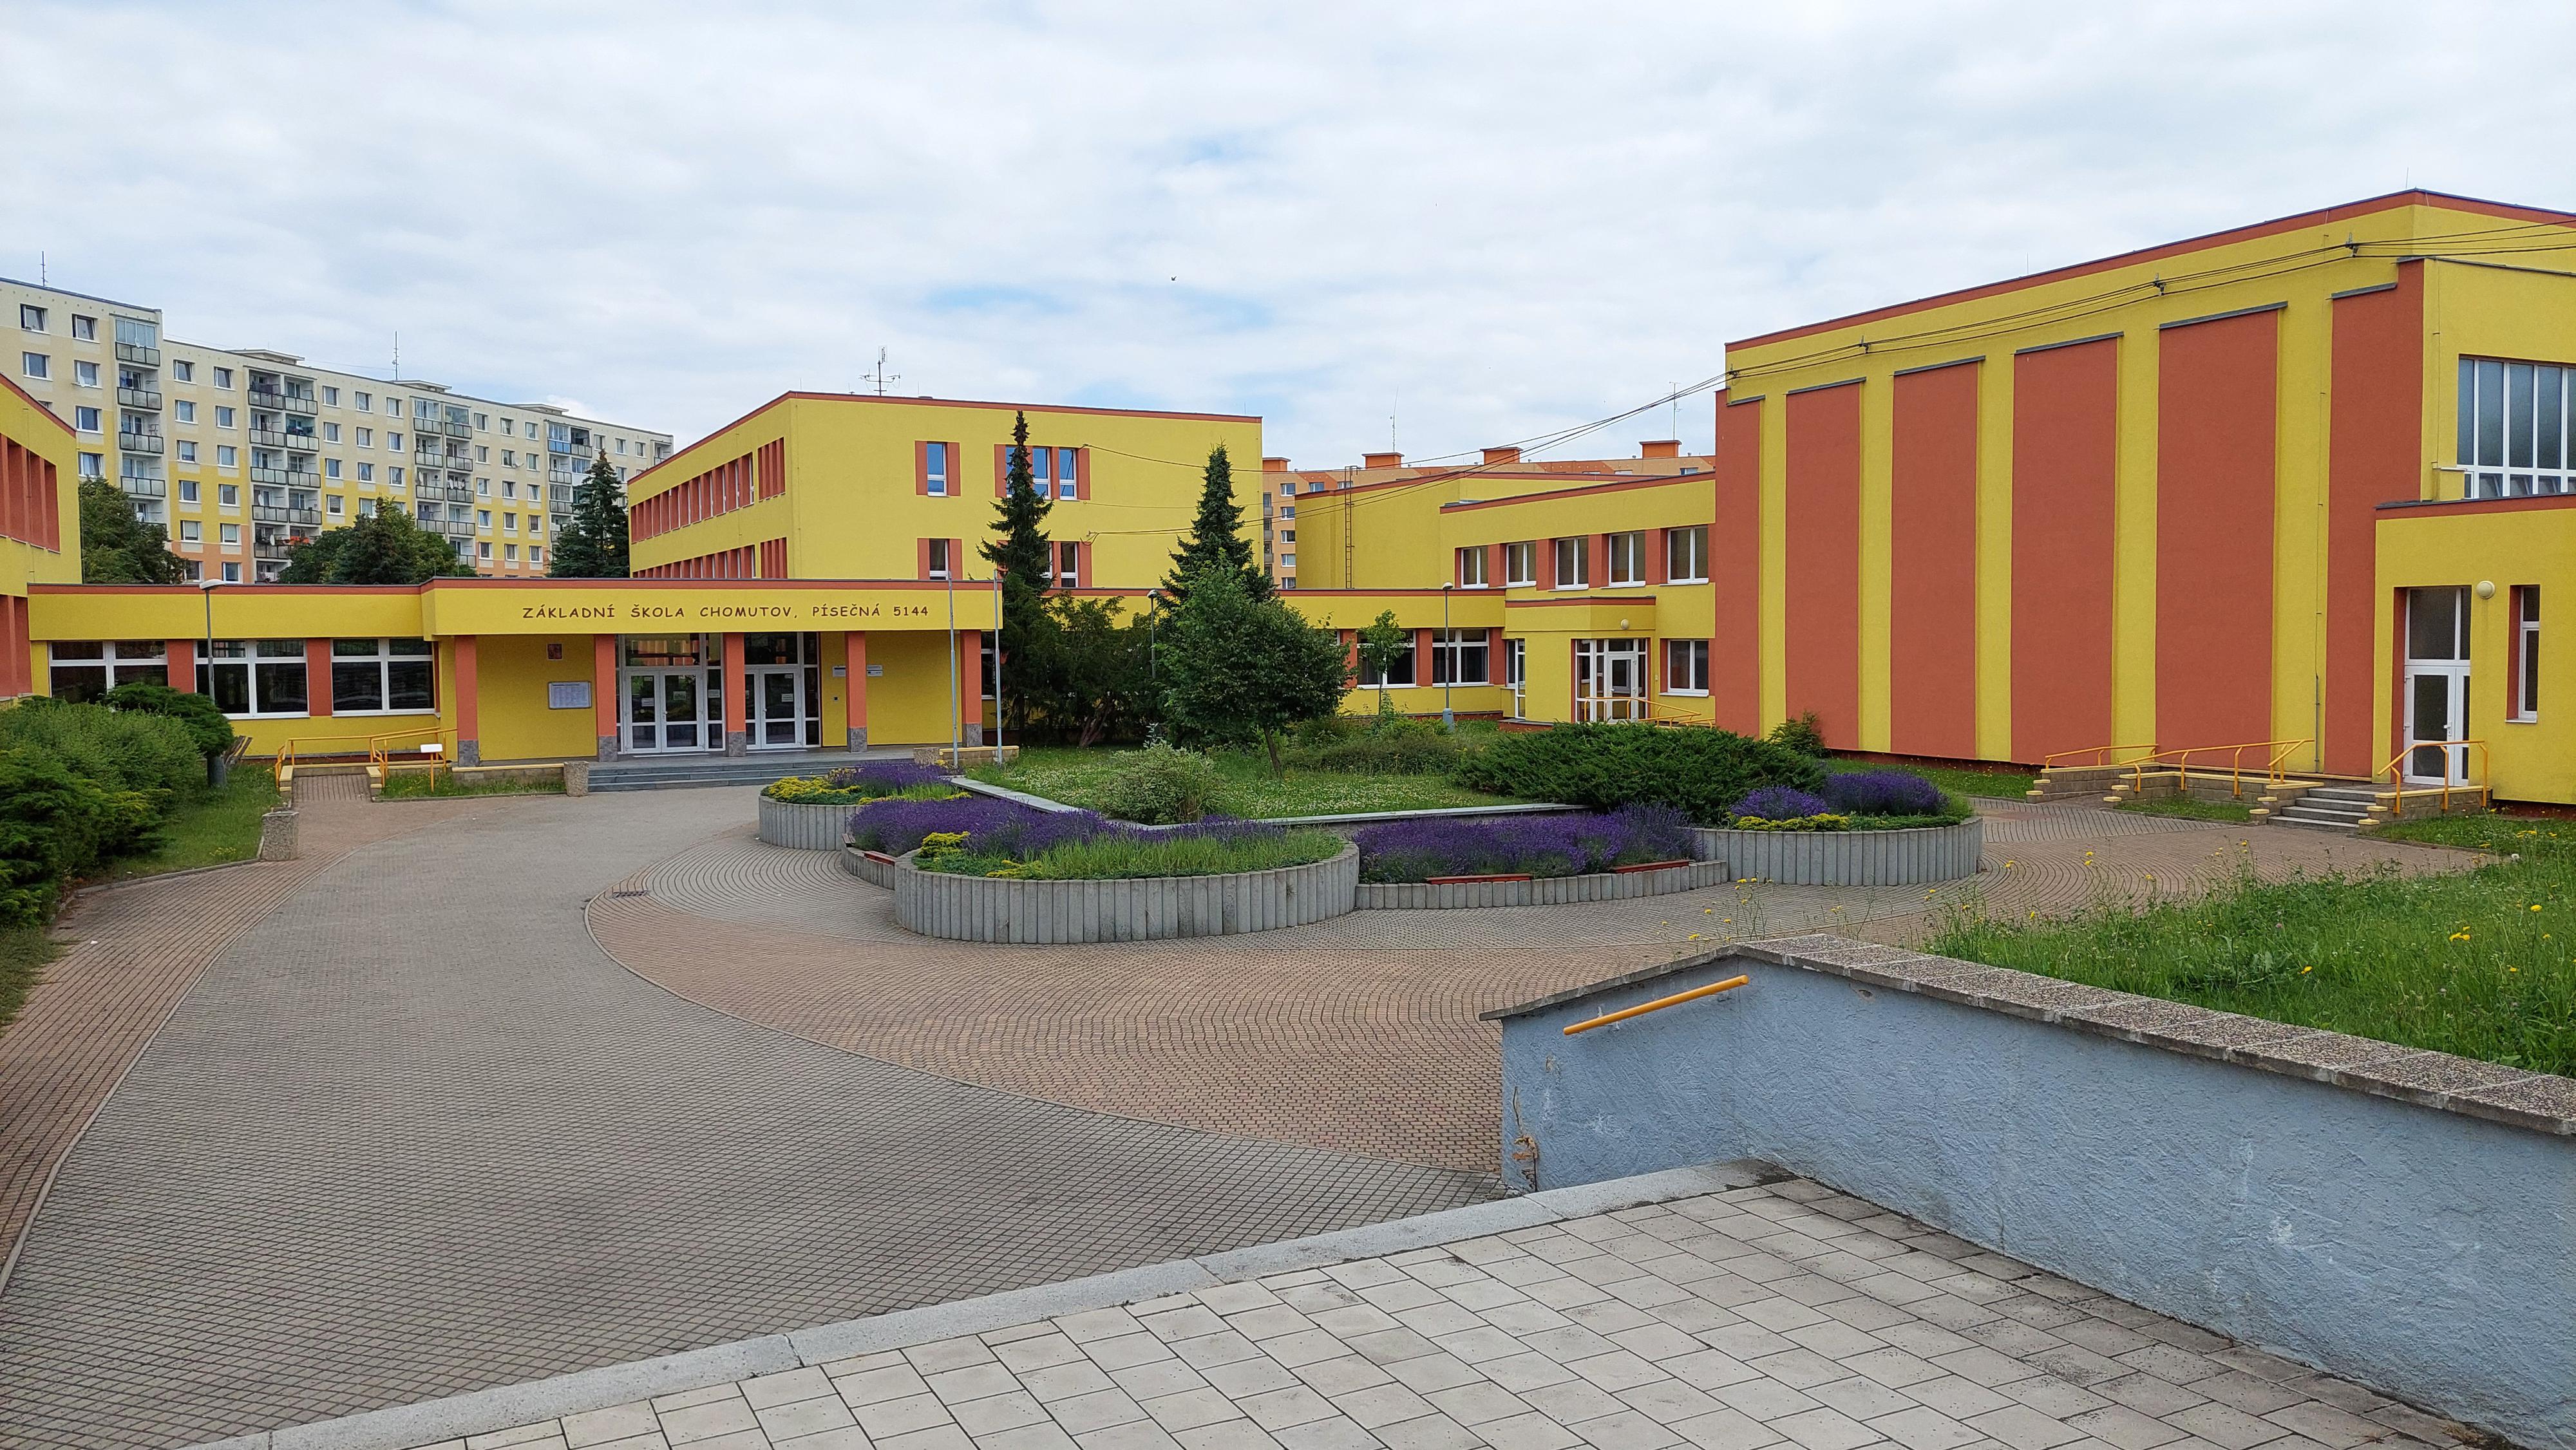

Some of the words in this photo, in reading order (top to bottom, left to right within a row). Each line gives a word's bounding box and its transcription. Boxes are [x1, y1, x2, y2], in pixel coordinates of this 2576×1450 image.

[522, 603, 615, 618] ZÁKLADNÍ
[630, 603, 685, 618] ŠKOLA
[700, 607, 798, 619] CHOMUTOV,
[812, 603, 881, 617] PÍSEČNÁ
[893, 606, 929, 616] 5144
